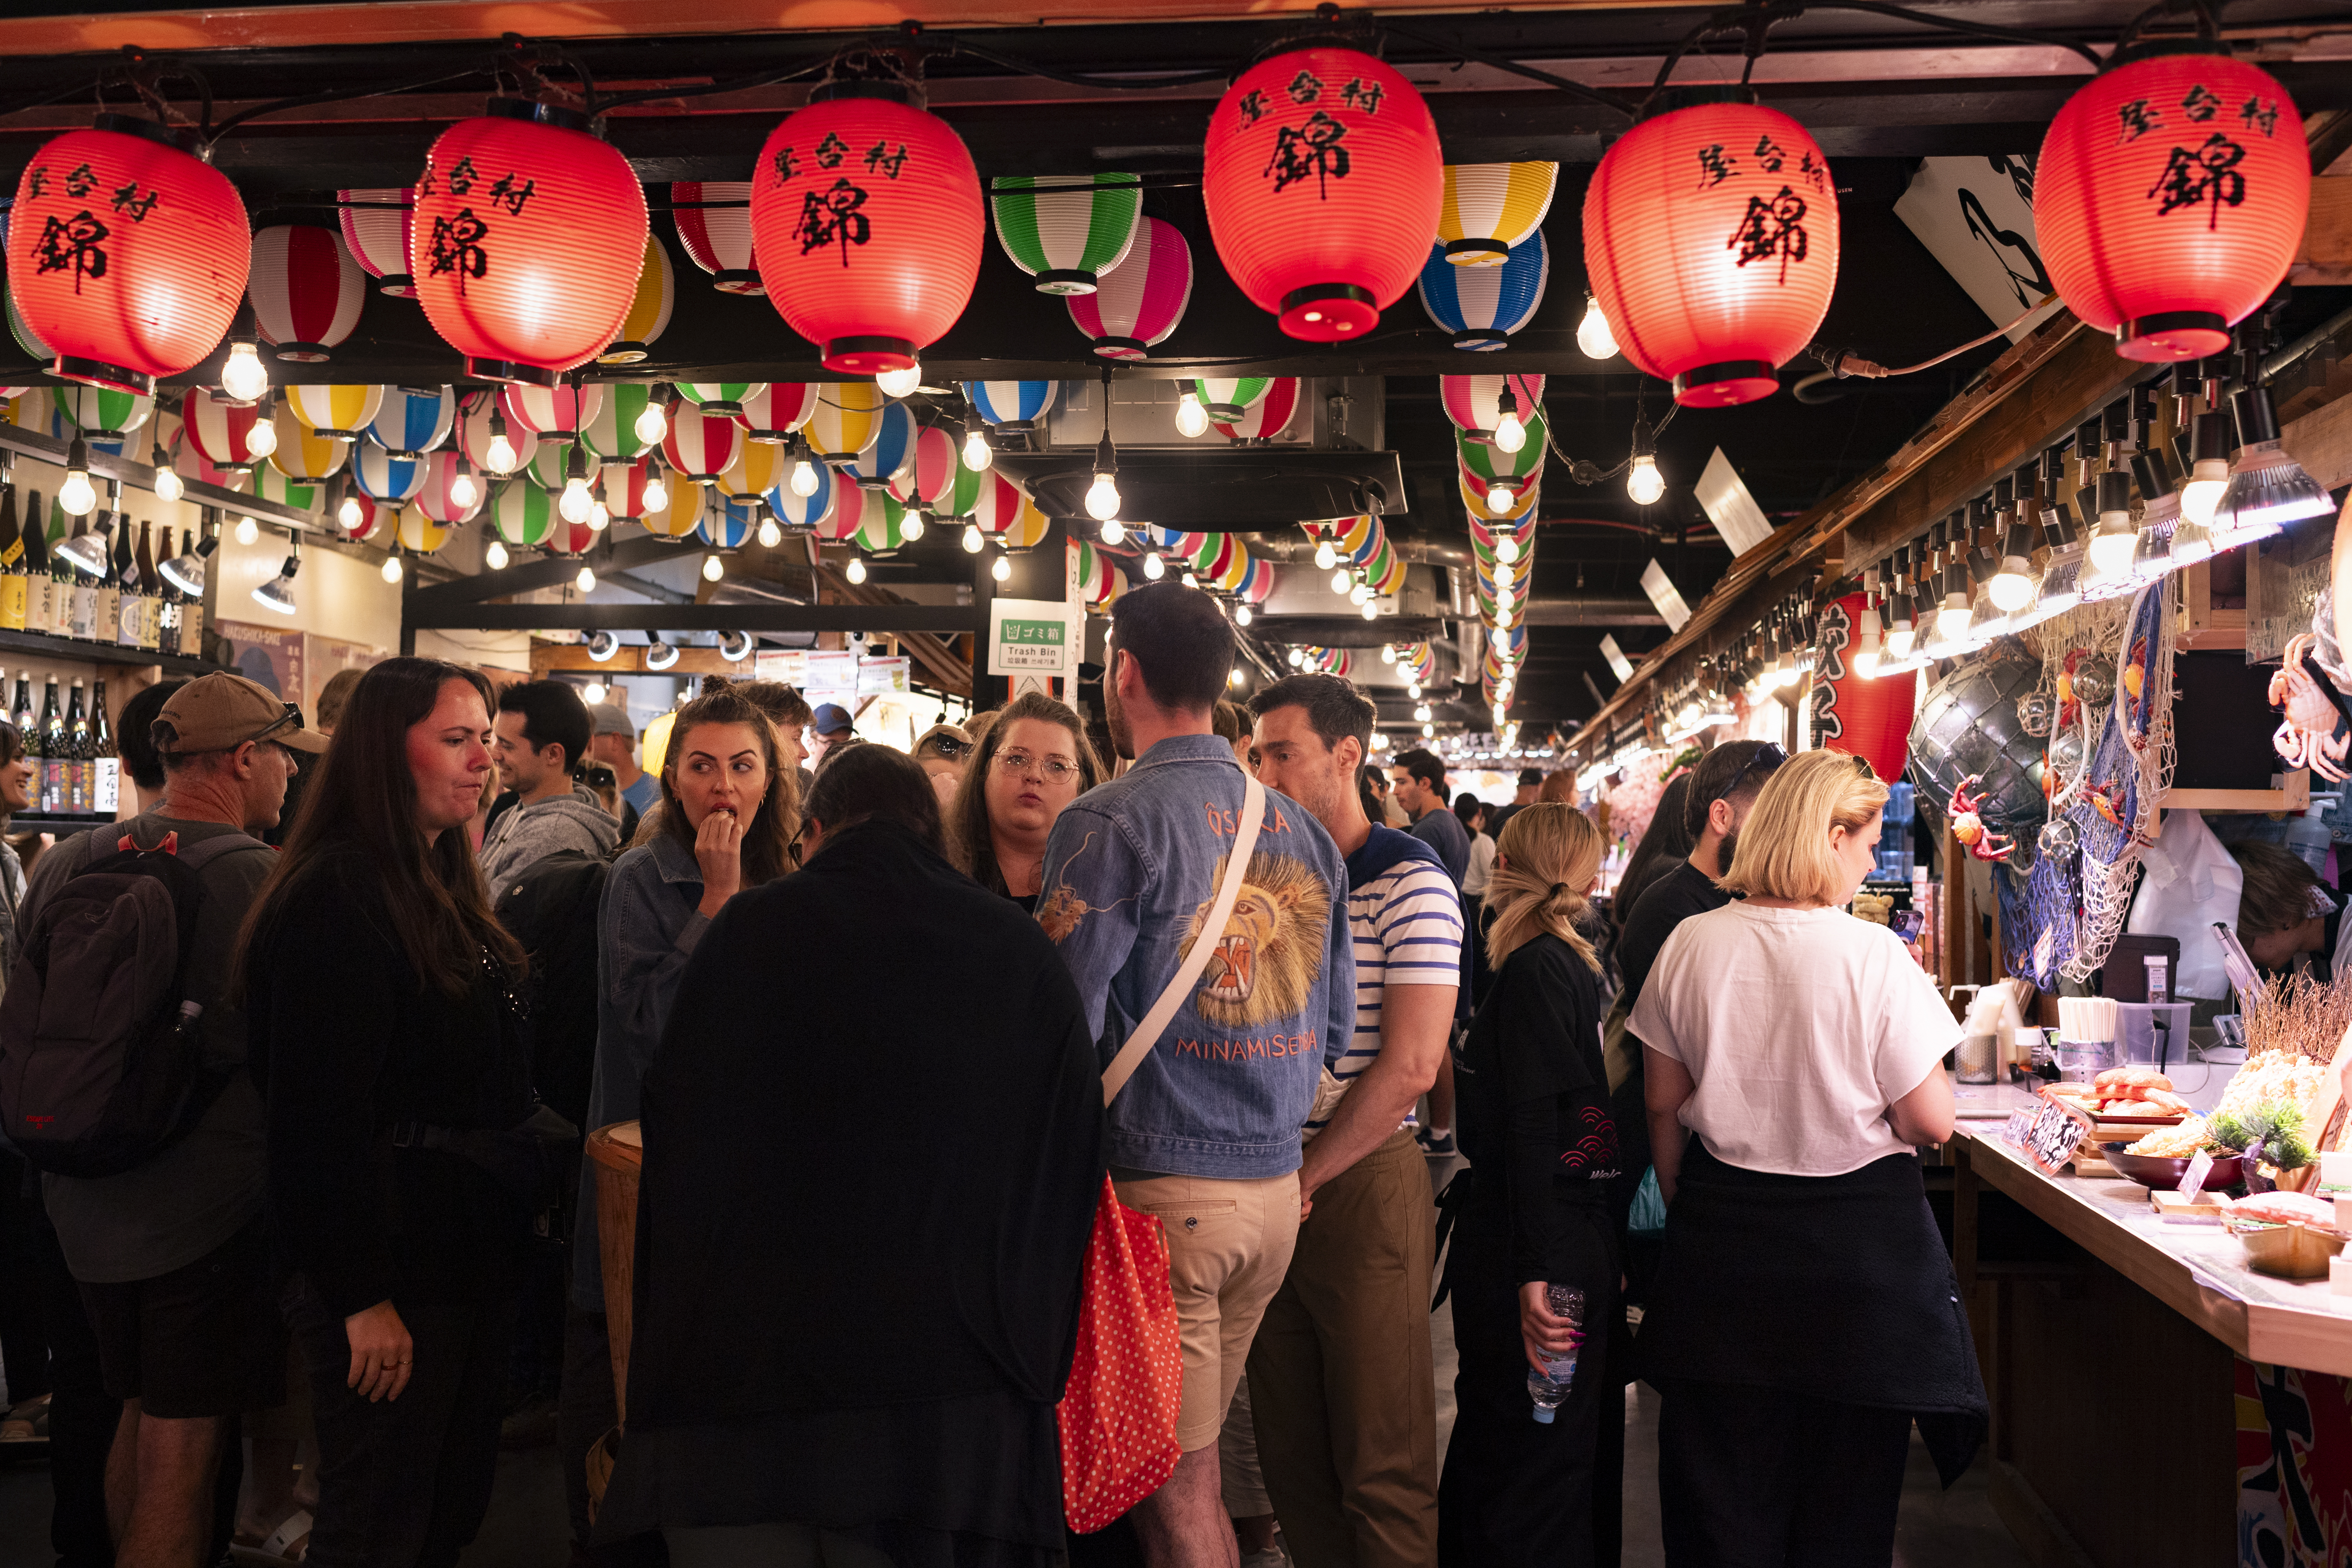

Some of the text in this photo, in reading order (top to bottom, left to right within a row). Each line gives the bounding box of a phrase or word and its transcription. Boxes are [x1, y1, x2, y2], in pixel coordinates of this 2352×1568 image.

[1237, 70, 1386, 131] 屋台村
[2116, 84, 2280, 146] 屋台村
[771, 131, 908, 189] 屋台村
[1263, 111, 1350, 200] 錦
[2148, 133, 2247, 230] 錦
[31, 210, 109, 295] 錦
[424, 207, 488, 296] 錦
[792, 177, 871, 267] 錦
[1728, 185, 1806, 285] 錦
[1008, 647, 1056, 656] Trash Bin
[1024, 627, 1059, 640] ゴミ箱
